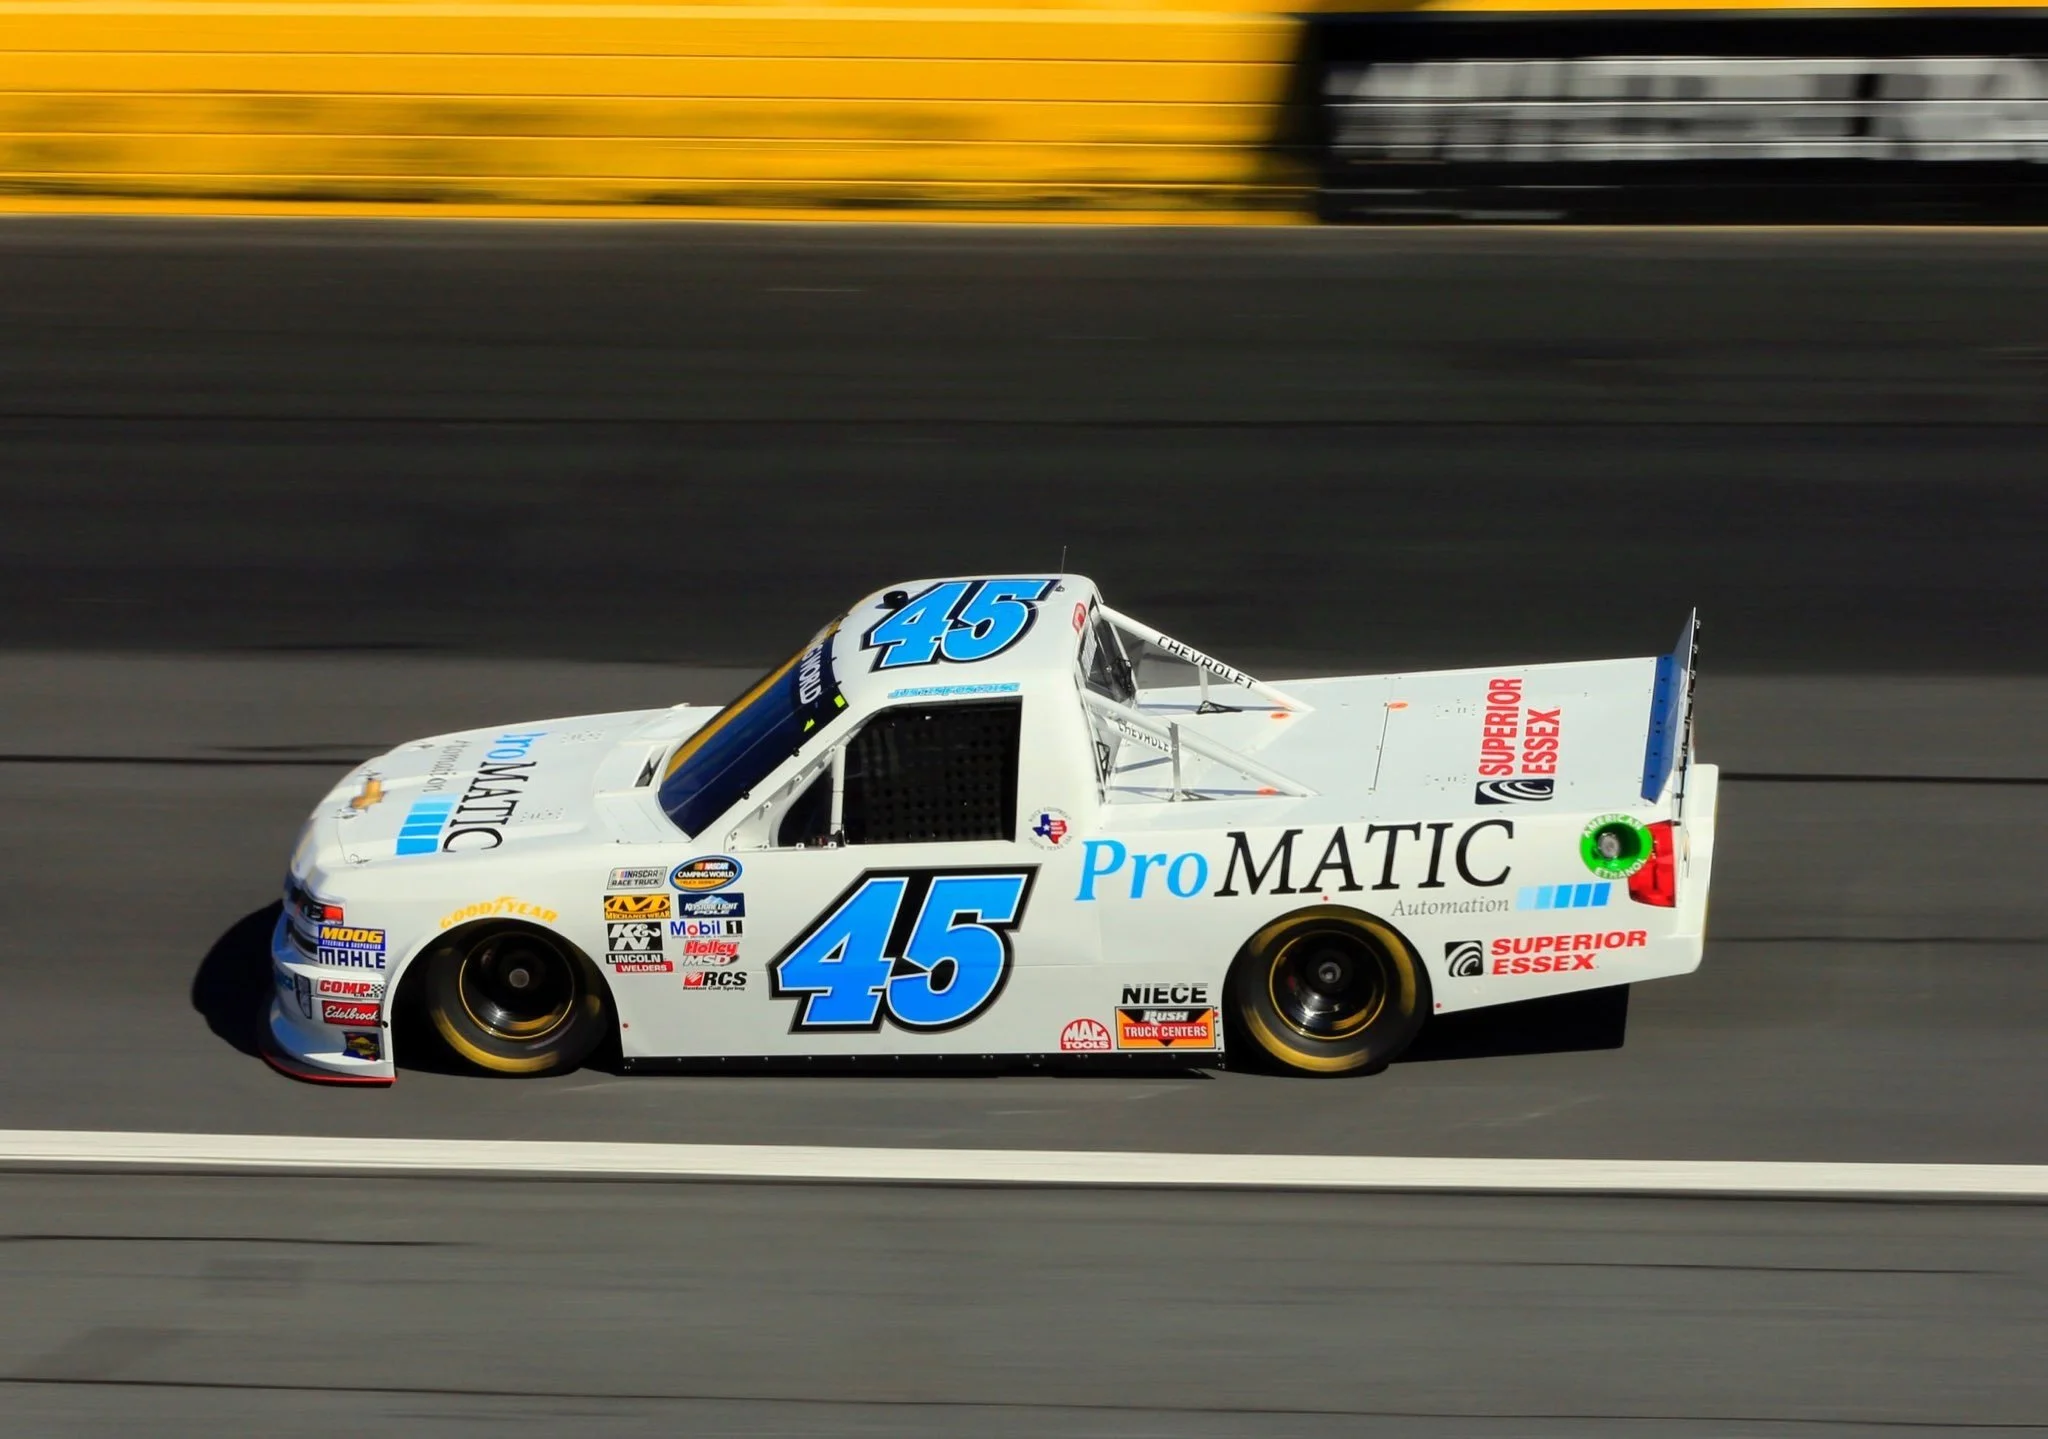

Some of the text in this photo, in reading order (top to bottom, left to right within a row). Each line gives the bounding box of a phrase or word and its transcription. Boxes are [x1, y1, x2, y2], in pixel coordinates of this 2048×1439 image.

[863, 580, 1062, 673] 45
[1156, 636, 1257, 690] CHEVROLET
[799, 646, 823, 705] WORLD
[1118, 720, 1170, 754] CHEVROLE
[1478, 678, 1523, 776] SUPERIOR
[1521, 706, 1562, 776] ESSEX
[1583, 813, 1646, 838] AMERICAN
[625, 869, 659, 879] NASCAR
[1594, 858, 1646, 880] ETHANOL
[611, 879, 632, 887] RACE
[439, 896, 559, 929] GOODYEAR
[647, 911, 671, 919] WEAR
[1390, 896, 1510, 917] Automation
[321, 926, 384, 944] MOOG
[670, 921, 720, 936] Mobil
[684, 940, 738, 957] Holley
[768, 863, 1043, 1034] 45
[1491, 930, 1647, 956] SUPERIOR
[318, 948, 386, 969] MAHLE
[608, 954, 661, 963] LINCOLN
[619, 963, 668, 972] WELDERS
[683, 955, 732, 967] MSD
[1491, 953, 1597, 976] ESSEX
[320, 980, 371, 995] COMP
[702, 971, 748, 986] RCS
[1121, 983, 1209, 1004] NIECE
[325, 1005, 380, 1021] Edelbrock
[1063, 1021, 1109, 1041] MAC
[1124, 1026, 1208, 1037] TRUCK CENTERS
[1063, 1041, 1110, 1049] TOOLS
